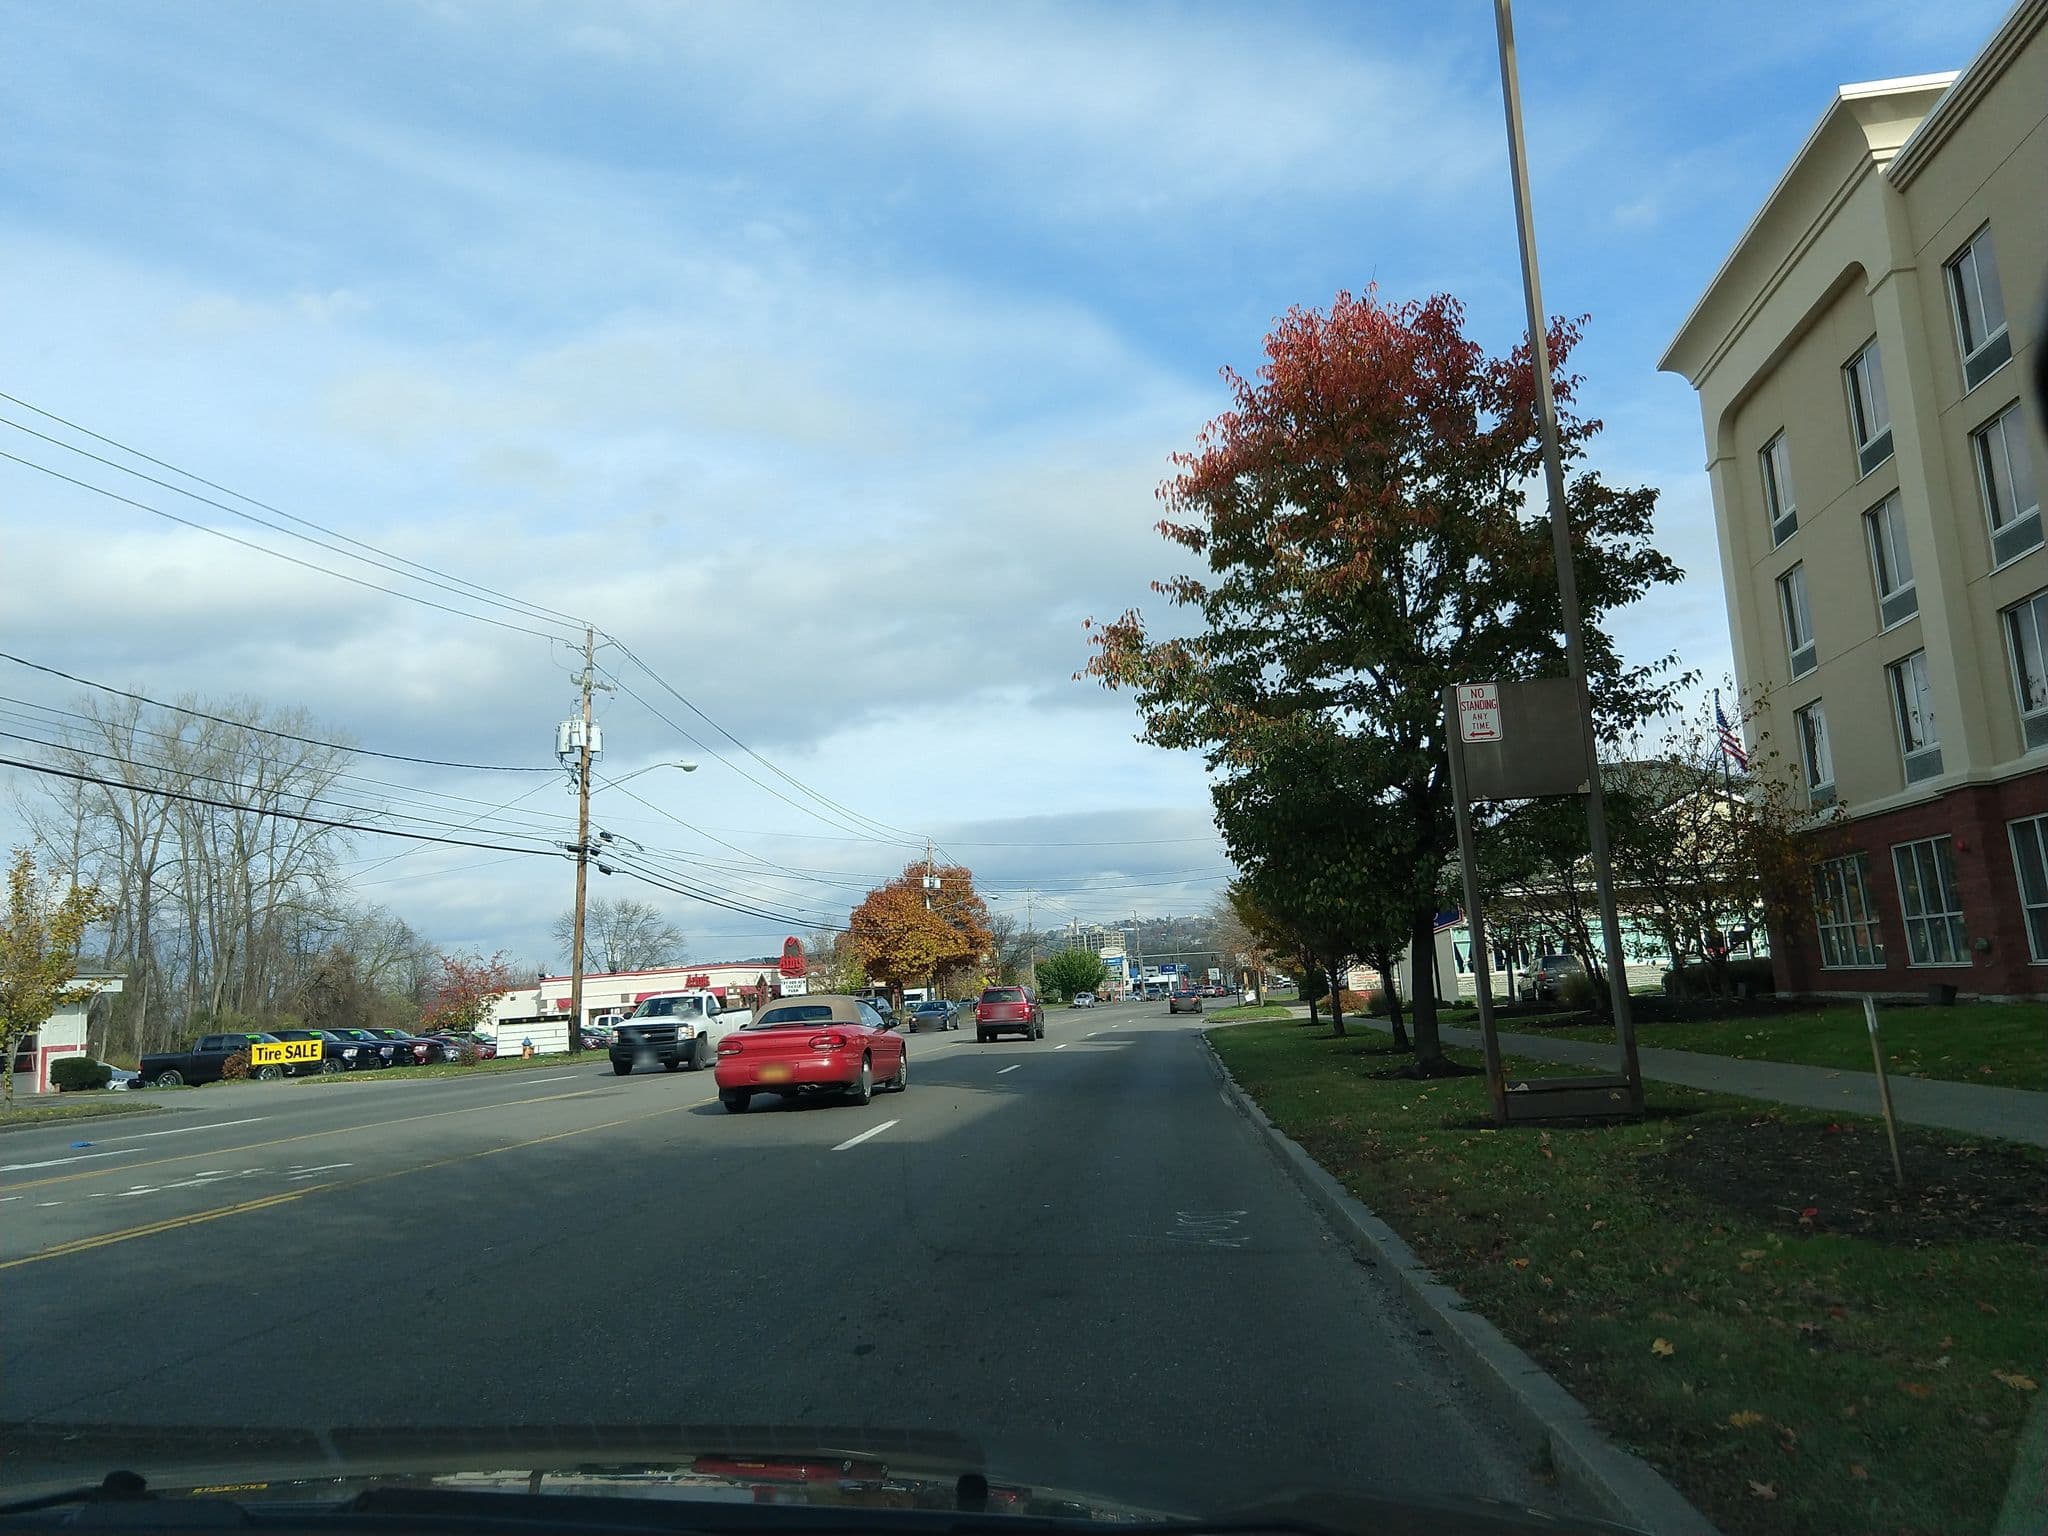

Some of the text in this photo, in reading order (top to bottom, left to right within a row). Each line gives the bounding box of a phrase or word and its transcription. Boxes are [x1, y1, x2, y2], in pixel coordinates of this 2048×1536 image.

[1471, 688, 1484, 698] NO
[1461, 699, 1497, 711] STANDING
[256, 1044, 318, 1061] Tire SALE
